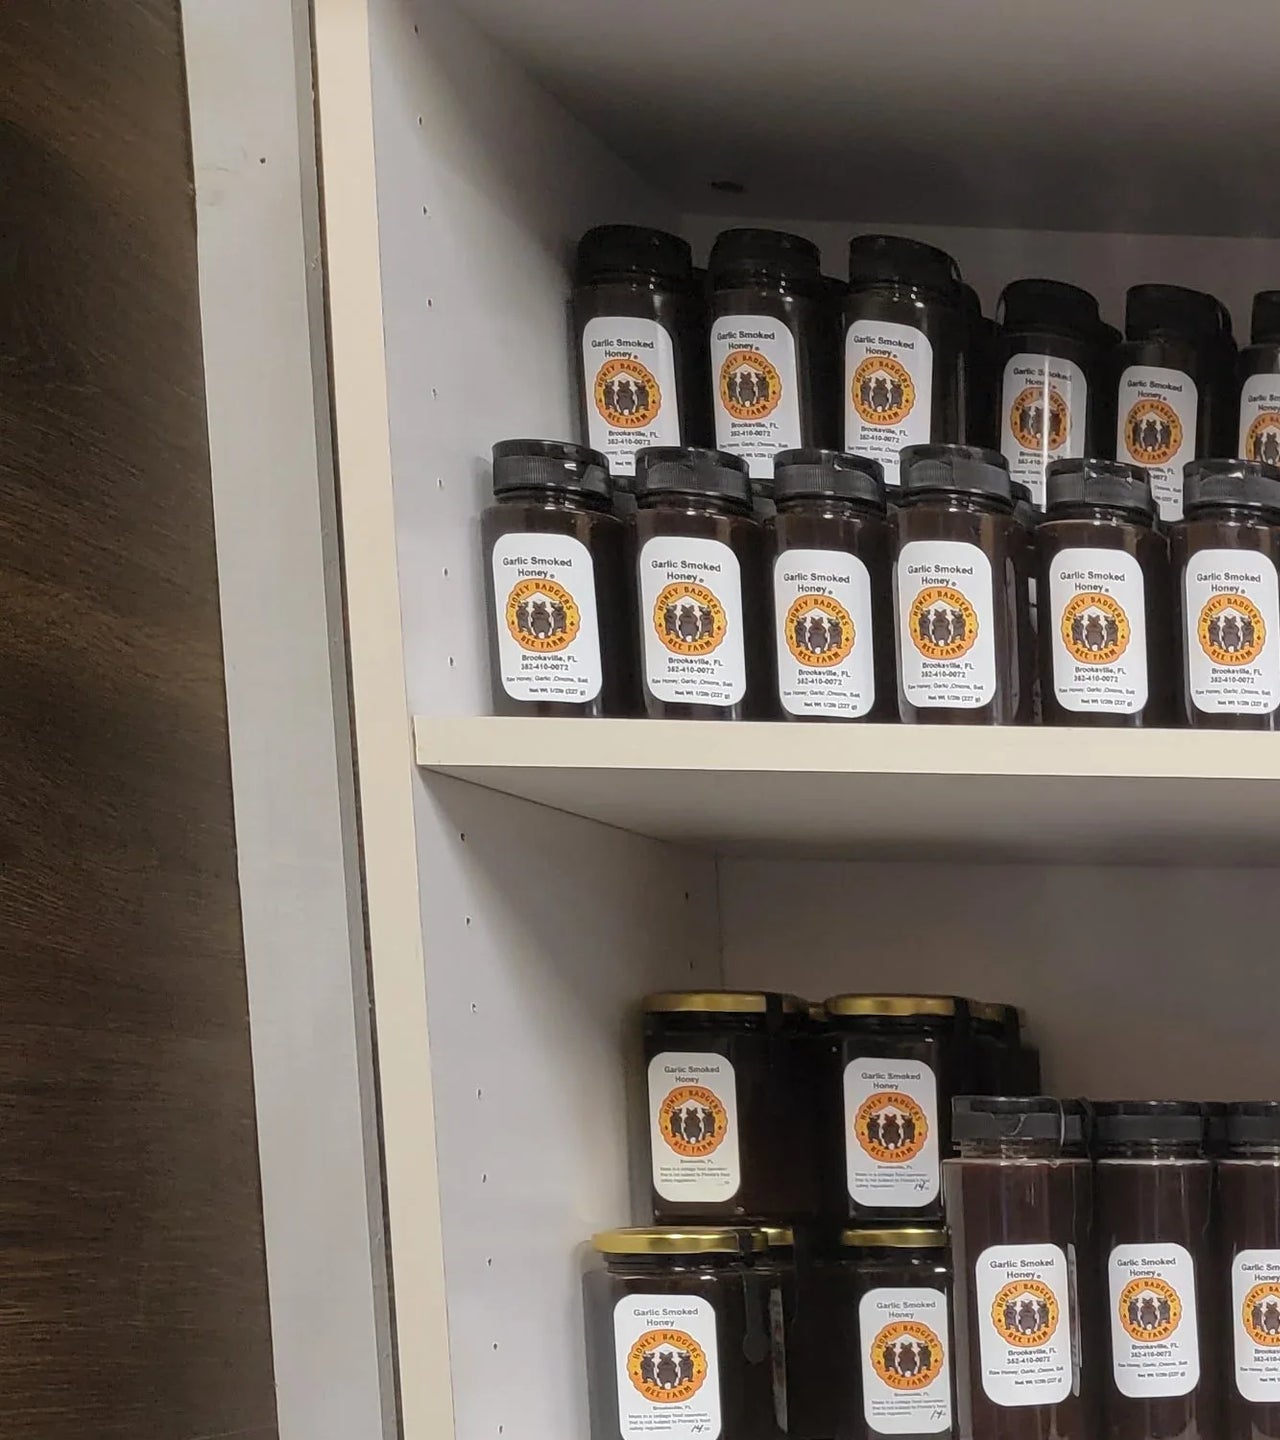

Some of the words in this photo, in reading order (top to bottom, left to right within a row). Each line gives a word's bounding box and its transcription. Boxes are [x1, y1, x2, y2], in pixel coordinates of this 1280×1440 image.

[592, 339, 614, 349] Garlic
[616, 339, 654, 349] Smoked
[605, 350, 632, 360] Honey
[502, 556, 528, 566] Garlic
[531, 557, 572, 567] Smoked
[651, 559, 677, 569] Garlic
[680, 561, 720, 571] Smoked
[518, 568, 548, 579] Honey
[908, 565, 932, 575] Garlic
[934, 565, 973, 575] Smoked
[666, 571, 697, 582] Honey
[783, 573, 808, 582] Garlic
[811, 573, 850, 583] Smoked
[921, 576, 950, 587] Honey
[1060, 572, 1085, 581] Garlic
[1087, 572, 1125, 581] Smoked
[1197, 573, 1221, 582] Garlic
[1224, 573, 1261, 582] Smoked
[797, 583, 827, 594] Honey
[1075, 582, 1103, 593] Honey
[1211, 584, 1239, 594] Honey
[990, 1260, 1017, 1270] Garlic
[1020, 1258, 1054, 1268] Smoked
[1007, 1271, 1035, 1280] Honey
[633, 1309, 660, 1317] Garlic
[662, 1308, 698, 1317] Smoked
[646, 1319, 674, 1327] Honey
